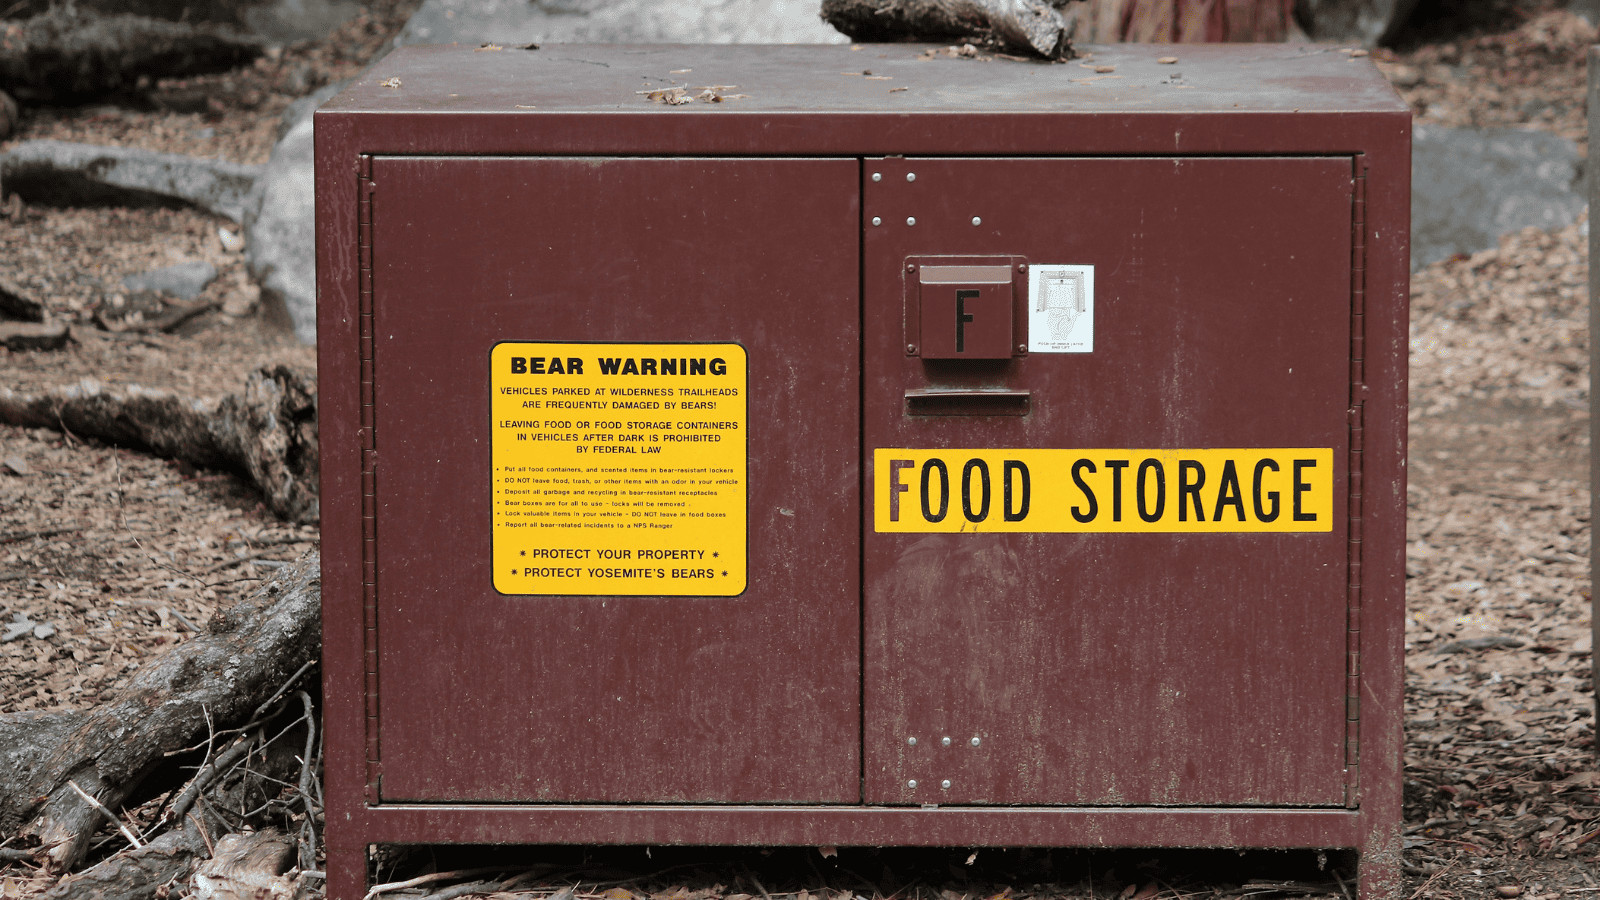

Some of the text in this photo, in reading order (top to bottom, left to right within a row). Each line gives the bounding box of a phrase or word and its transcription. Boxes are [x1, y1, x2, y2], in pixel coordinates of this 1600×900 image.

[955, 289, 980, 353] F
[511, 357, 727, 376] BEAR WARNING
[500, 386, 738, 397] VEHICLES PARKED AT WILDERNESS TRAILHEADS
[522, 400, 716, 410] ARE FREQUENTLY DAMAGED BY BEARS!
[500, 419, 738, 430] LEAVING FOOD OR FOOD STORAGE CONTAINERS
[517, 432, 721, 443] IN VEHICLES AFTER DARK IS PROHIBITED
[577, 445, 661, 454] BY FEDERAL LAW
[504, 488, 531, 496] Deposit
[542, 489, 571, 497] garbage
[587, 489, 618, 497] recycling
[678, 489, 718, 497] receptacles
[889, 458, 1318, 523] FOOD STORAGE
[504, 521, 528, 529] Report
[649, 522, 673, 530] Ranger
[533, 548, 705, 560] PROTECT YOUR PROPERTY
[524, 567, 714, 579] PROTECT YOSEMITE'S BEARS
